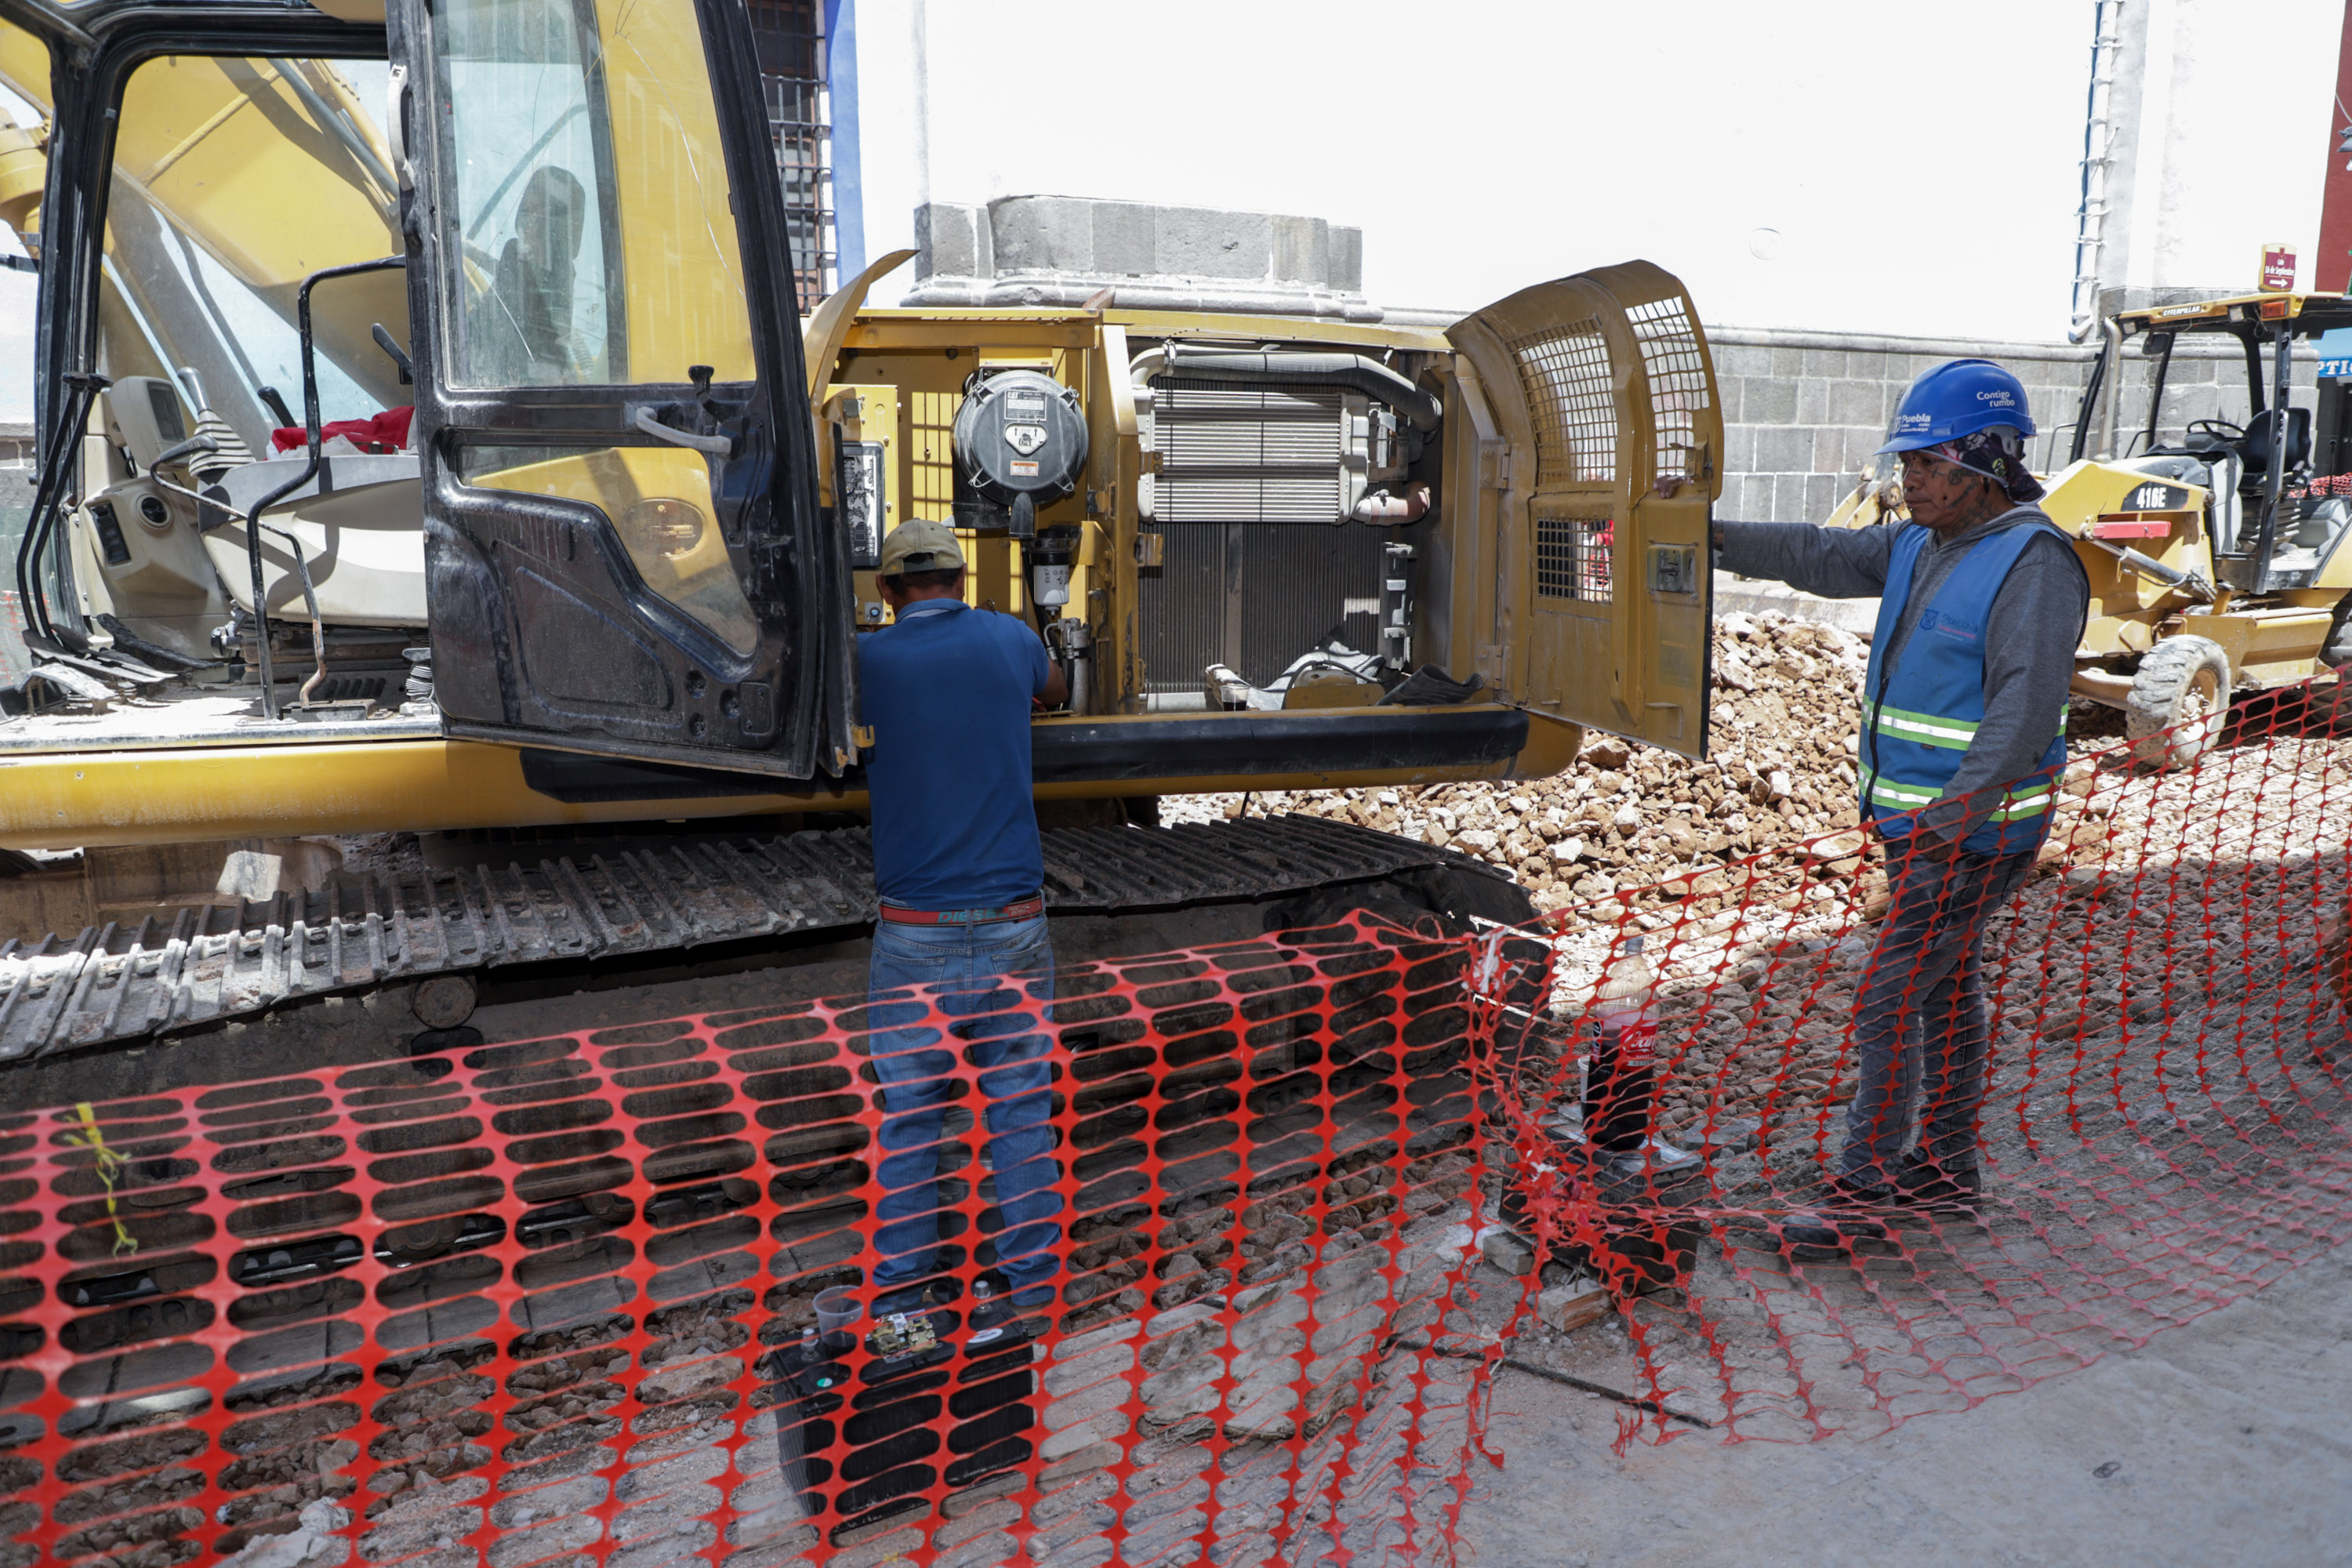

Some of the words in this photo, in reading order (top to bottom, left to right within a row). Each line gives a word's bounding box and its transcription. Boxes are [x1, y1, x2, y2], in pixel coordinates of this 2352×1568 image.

[2162, 305, 2201, 317] CATERPILLAR
[1976, 390, 2010, 401] Contigo
[1989, 397, 2015, 408] rumbo
[1901, 413, 1931, 424] Puebla
[2136, 487, 2167, 509] 416E
[937, 907, 1009, 924] DIESEL
